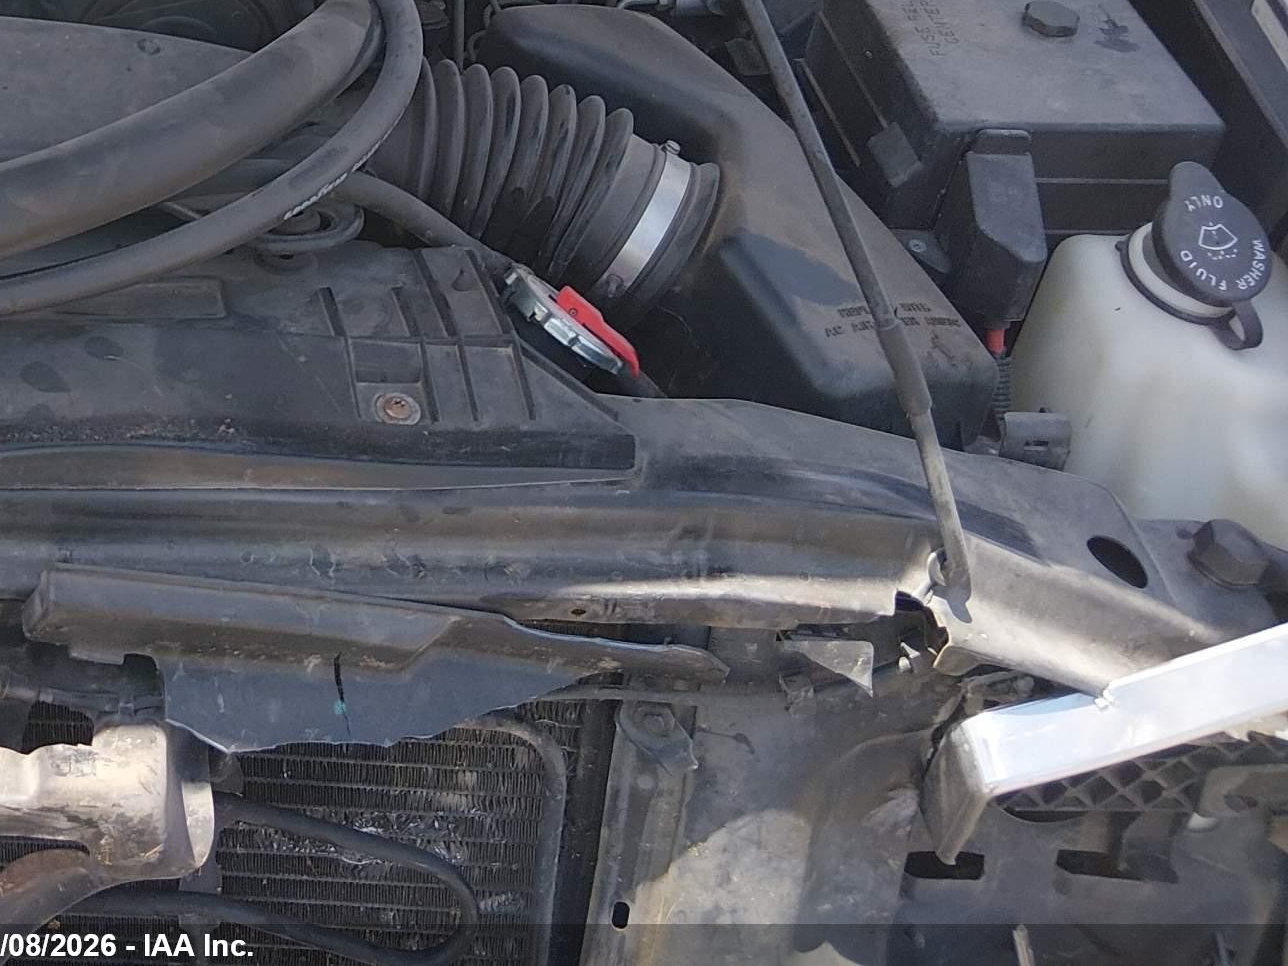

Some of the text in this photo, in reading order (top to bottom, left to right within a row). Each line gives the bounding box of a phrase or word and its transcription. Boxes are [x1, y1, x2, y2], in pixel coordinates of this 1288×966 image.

[1180, 195, 1266, 291] WASHER FLUID ONLY
